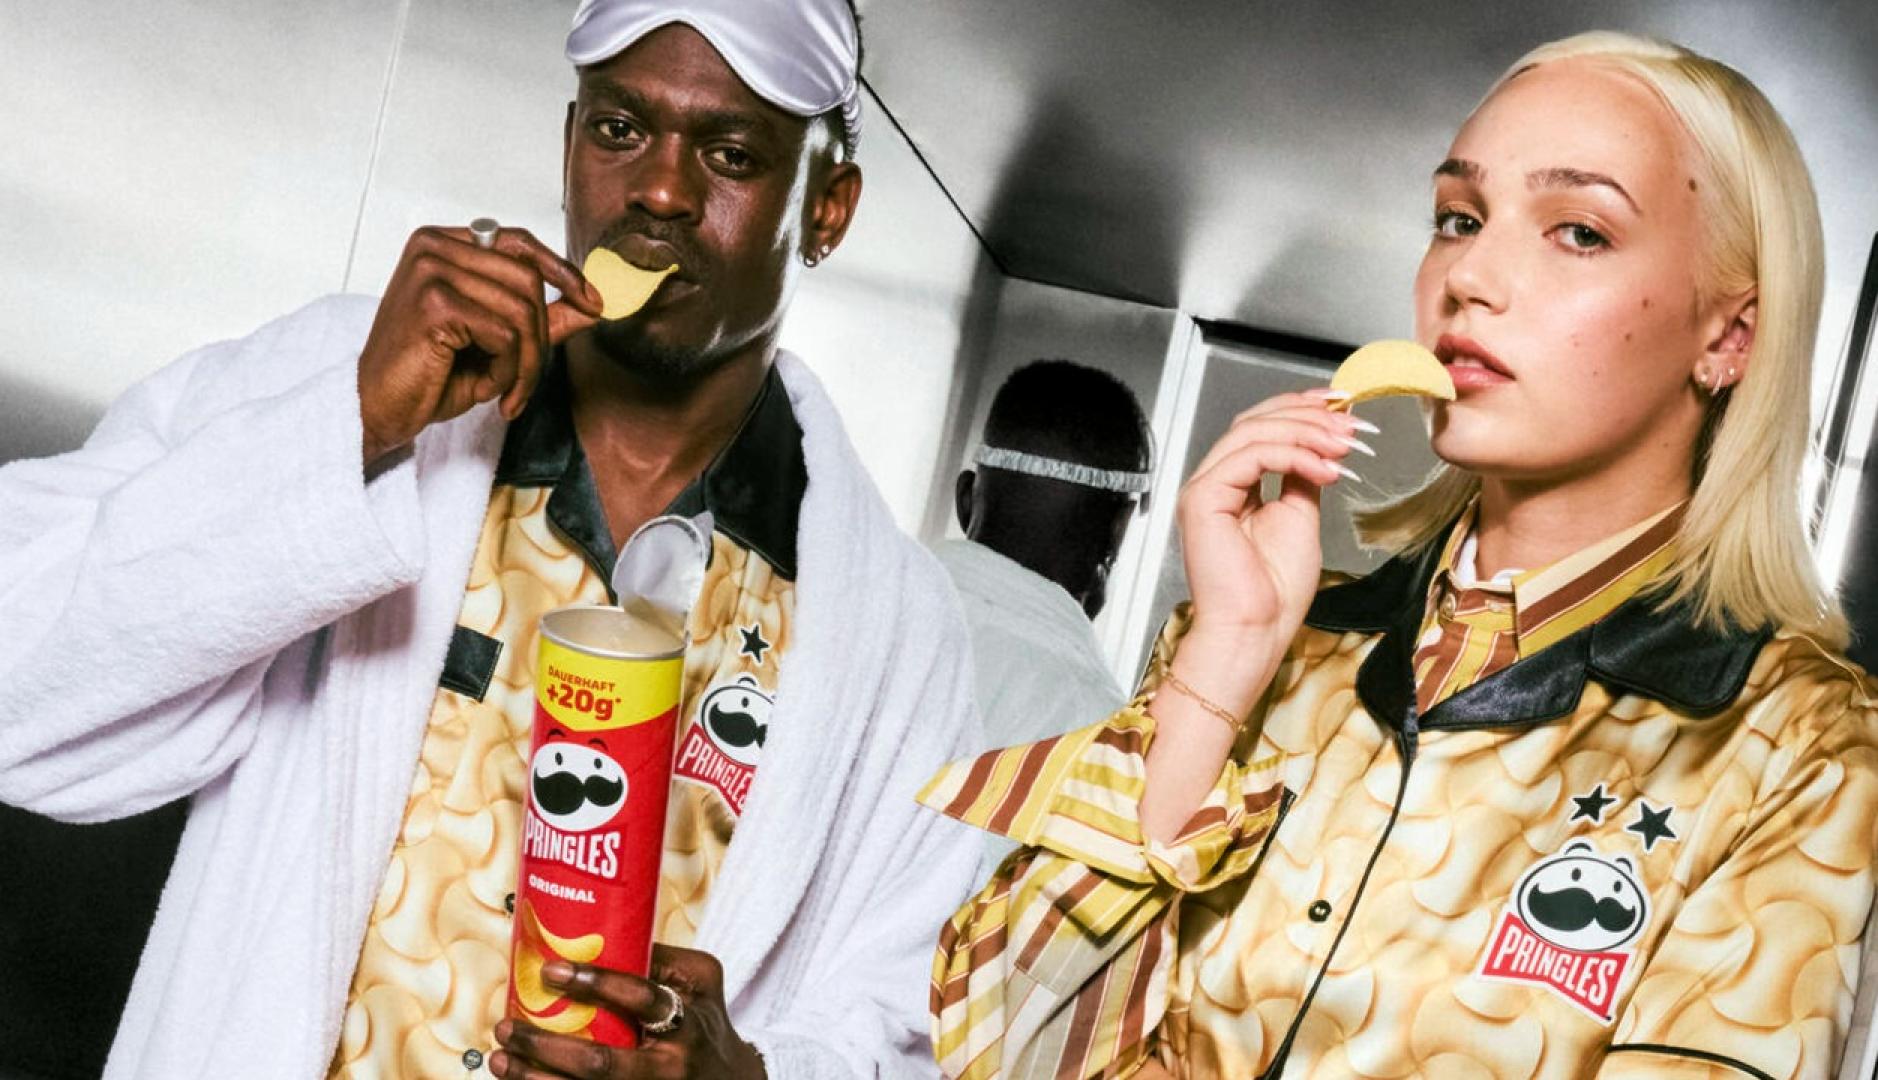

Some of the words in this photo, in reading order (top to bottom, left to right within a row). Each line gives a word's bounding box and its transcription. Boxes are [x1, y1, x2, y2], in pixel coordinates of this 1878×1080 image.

[548, 664, 616, 692] DAUERHAFT
[678, 733, 753, 809] PRINGLE
[524, 809, 620, 879] PRINGLES
[529, 874, 596, 903] ORIGINAL
[1493, 924, 1617, 1006] PRINGLES
